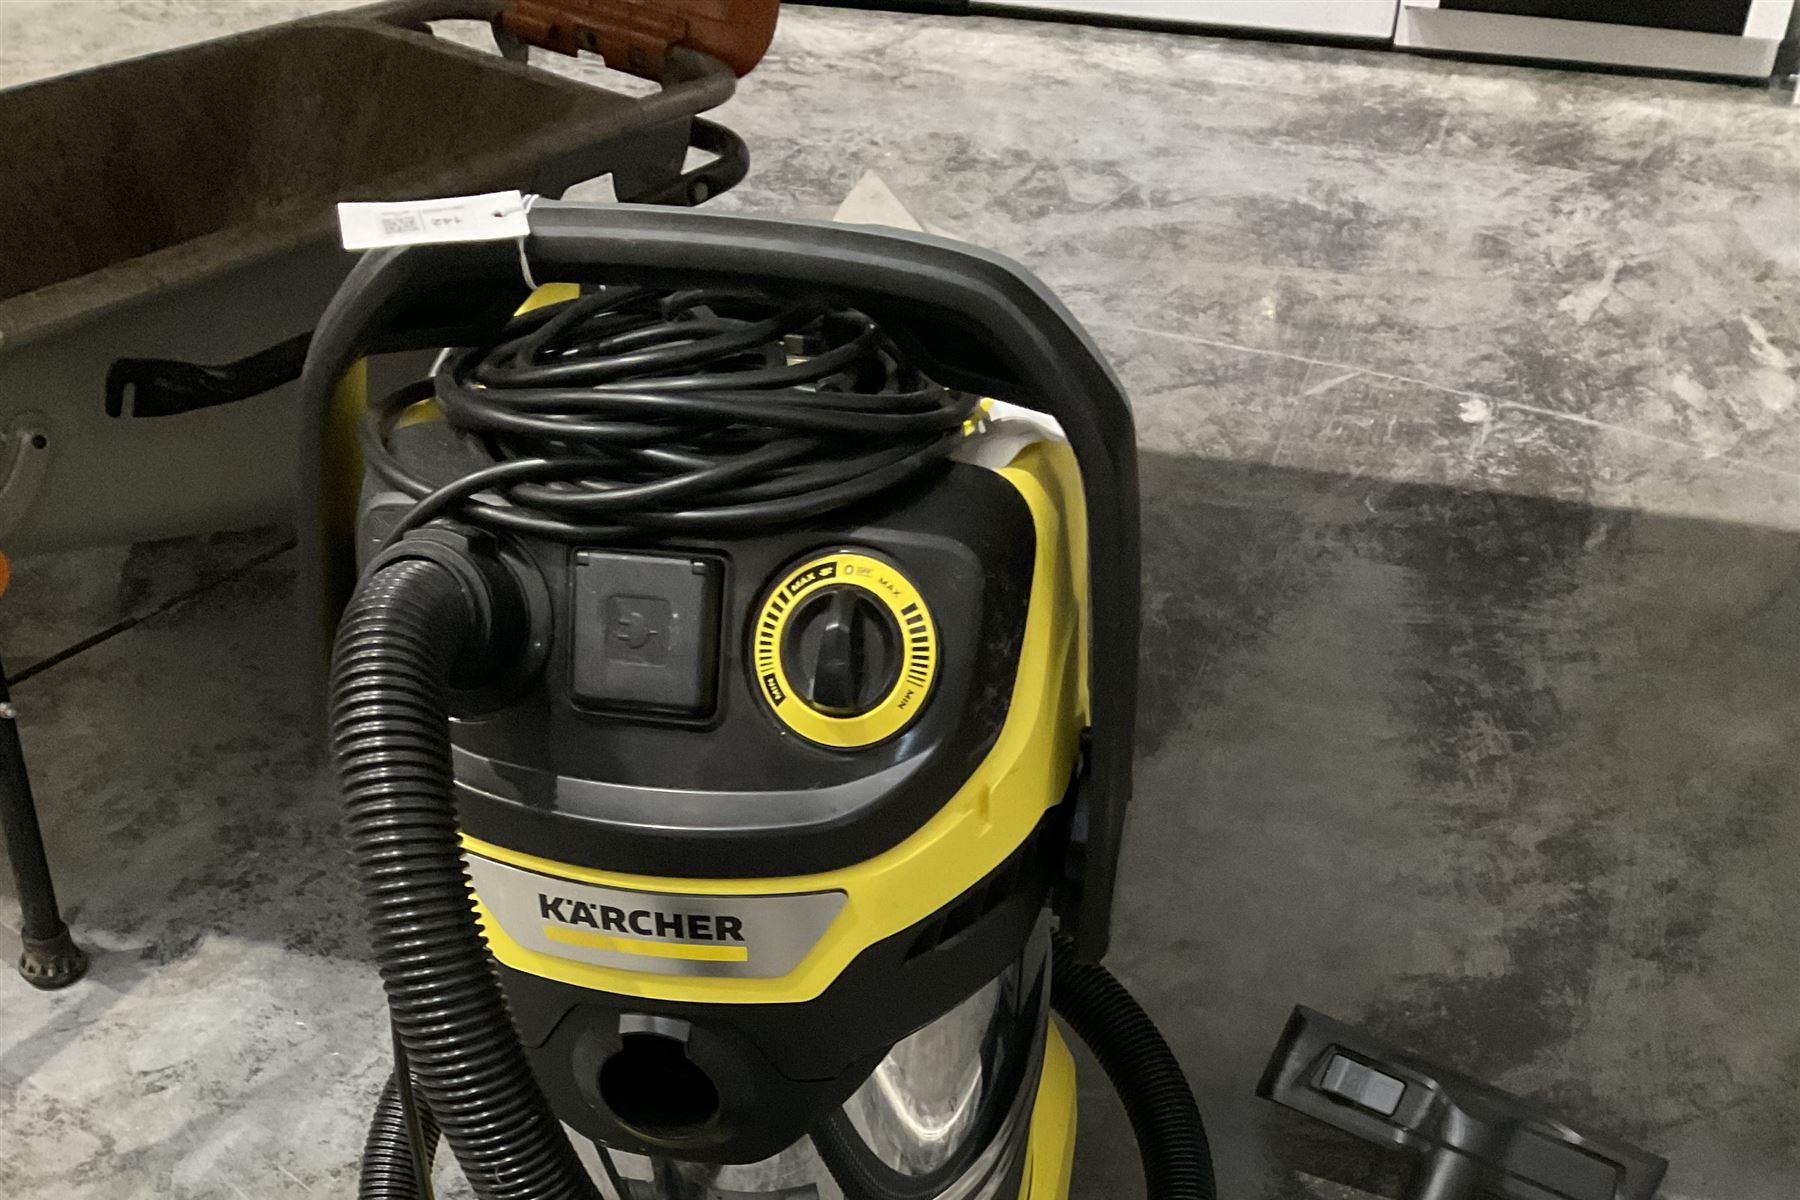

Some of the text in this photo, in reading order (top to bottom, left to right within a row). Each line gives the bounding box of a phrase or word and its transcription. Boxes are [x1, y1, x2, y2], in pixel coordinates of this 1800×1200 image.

[791, 572, 817, 592] MAX
[879, 578, 902, 597] MAX
[767, 678, 783, 700] MIN
[896, 688, 915, 710] MIN
[538, 893, 746, 942] KÄRCHER
